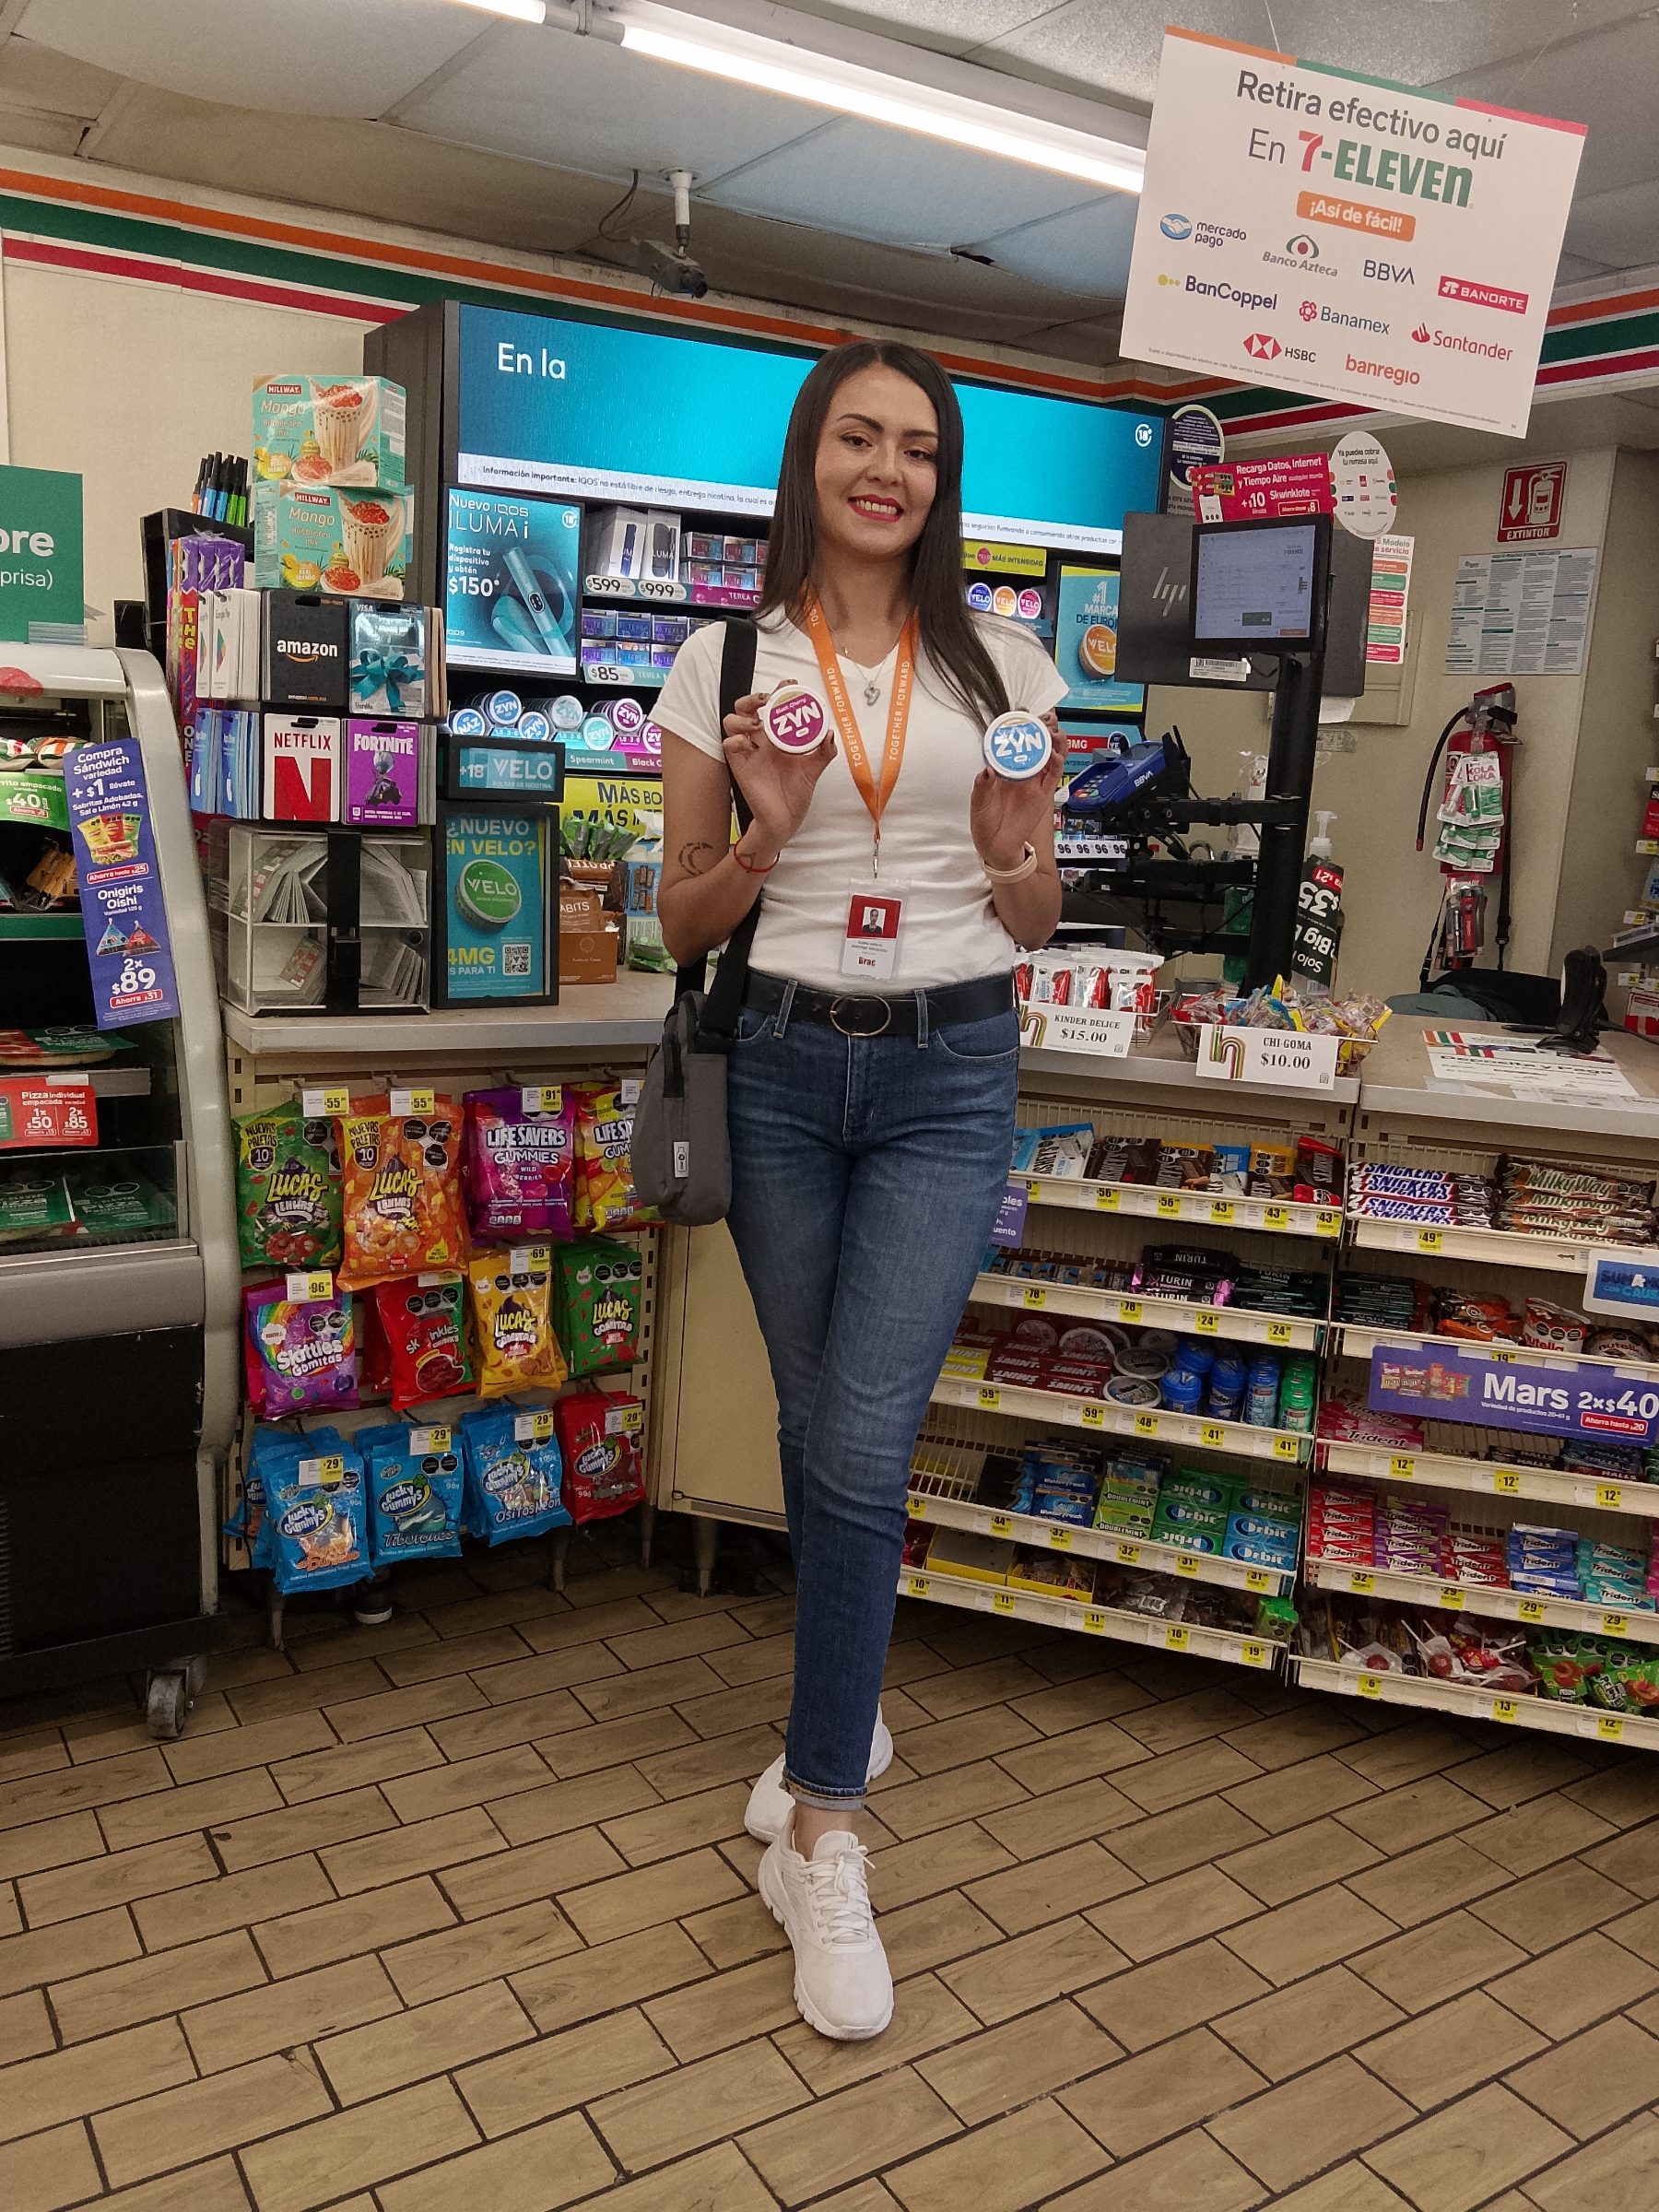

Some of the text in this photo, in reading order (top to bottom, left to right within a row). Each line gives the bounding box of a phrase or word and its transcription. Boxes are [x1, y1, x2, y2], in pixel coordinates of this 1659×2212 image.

[1237, 70, 1507, 160] Retira efectivo aquí
[1248, 128, 1286, 165] En
[1310, 200, 1402, 233] ¡Así de fácil!
[1194, 232, 1223, 248] pago
[1197, 222, 1247, 241] mercado
[1262, 252, 1338, 276] Banco Azteca
[1363, 259, 1415, 285] BBVA
[1185, 275, 1277, 311] BanCoppel
[1461, 287, 1524, 310] BANORTE
[1321, 306, 1390, 335] Banamex
[1285, 347, 1316, 362] HSBC
[1433, 331, 1513, 361] Santander
[498, 342, 566, 380] En la
[1346, 354, 1420, 385] banregio
[261, 400, 306, 417] Mango
[1236, 457, 1322, 475] Recarga Datos, Internet
[483, 465, 530, 479] Información
[531, 471, 577, 484] importante:
[578, 477, 597, 487] IQOS
[1238, 480, 1242, 488] y
[1243, 476, 1271, 488] Tiempo
[1273, 473, 1287, 483] Aire
[449, 493, 528, 517] Nuevo IQOS
[1249, 491, 1265, 508] $10
[1270, 488, 1310, 500] Skwinklote
[288, 507, 335, 527] Mango
[449, 510, 528, 538] ILUMA i
[1506, 527, 1550, 540] EXTINTOR
[449, 544, 481, 555] Registra
[1381, 547, 1408, 555] servicio
[1383, 538, 1410, 547] Modelo
[449, 555, 489, 566] dispositivo
[454, 566, 477, 574] obtén
[0, 569, 53, 590] prisa)
[587, 577, 621, 593] $599
[641, 582, 674, 597] $999
[1092, 581, 1107, 605] #1
[356, 603, 373, 612] VISA
[1085, 604, 1118, 617] MARCA
[1077, 614, 1088, 624] DE
[277, 639, 337, 657] amazon
[592, 666, 619, 680] $85
[790, 698, 806, 708] Cherry
[889, 662, 910, 761] TOGETHER FORWARD
[772, 702, 820, 735] ZYN
[274, 733, 331, 750] NETFLIX
[354, 734, 415, 755] FORTNITE
[994, 730, 1043, 759] ZYN
[77, 747, 123, 763] Compra
[571, 756, 615, 765] Spearmint
[632, 758, 654, 767] Black
[74, 756, 129, 775] Sándwich
[83, 766, 122, 780] variedad
[459, 759, 552, 780] +18 VELO
[1466, 764, 1495, 774] KOLA
[1134, 770, 1153, 787] BBVA
[1467, 772, 1495, 782] LOKA
[87, 778, 104, 797] $1
[597, 782, 640, 804] MÁS
[73, 799, 102, 811] Sabritas
[446, 819, 530, 836] ¿NUEVO
[472, 840, 537, 855] VELO?
[88, 871, 113, 881] Ahorra
[98, 885, 143, 900] Onigiris
[466, 877, 517, 895] VELO
[107, 895, 137, 909] Oishi
[124, 959, 143, 971] 2x
[459, 966, 495, 975] PARA TI
[1298, 953, 1324, 973] Solo
[112, 968, 155, 994] $89
[1054, 1014, 1121, 1030] KINDER DELICE
[1060, 1028, 1107, 1043] $15.00
[1260, 1053, 1311, 1070] $10.00
[245, 1123, 276, 1136] NUEVAS
[348, 1121, 379, 1136] NUEVAS
[487, 1126, 567, 1147] LIFE SAVERS
[248, 1135, 277, 1148] PALETAS
[350, 1134, 381, 1148] PALETAS
[256, 1151, 269, 1161] 10
[361, 1149, 374, 1161] 10
[494, 1151, 559, 1165] GUMMIES
[1365, 1163, 1446, 1181] SNICKERS
[267, 1172, 329, 1201] LUCAS
[369, 1169, 424, 1201] LUCAS
[1368, 1198, 1449, 1216] SNICKERS
[1175, 1253, 1207, 1265] TURIN
[1160, 1275, 1194, 1287] TURIN
[276, 1339, 343, 1371] Skittles
[995, 1356, 1041, 1368] SMINT
[292, 1355, 342, 1377] Gomitas
[1047, 1381, 1095, 1394] SMINT
[1484, 1372, 1569, 1410] Mars
[1347, 1430, 1406, 1448] Trident
[1044, 1477, 1086, 1488] Winterfresh
[386, 1485, 413, 1502] Lucky
[1107, 1493, 1150, 1508] DOUBLEMINT
[288, 1506, 315, 1523] Lucky
[496, 1502, 535, 1524] Ositos
[1040, 1509, 1084, 1520] Winterfresh
[1323, 1512, 1359, 1522] Trident
[1099, 1523, 1144, 1537] DOUBLEMINT
[1235, 1517, 1288, 1539] Orbit
[1231, 1541, 1285, 1565] Orbit
